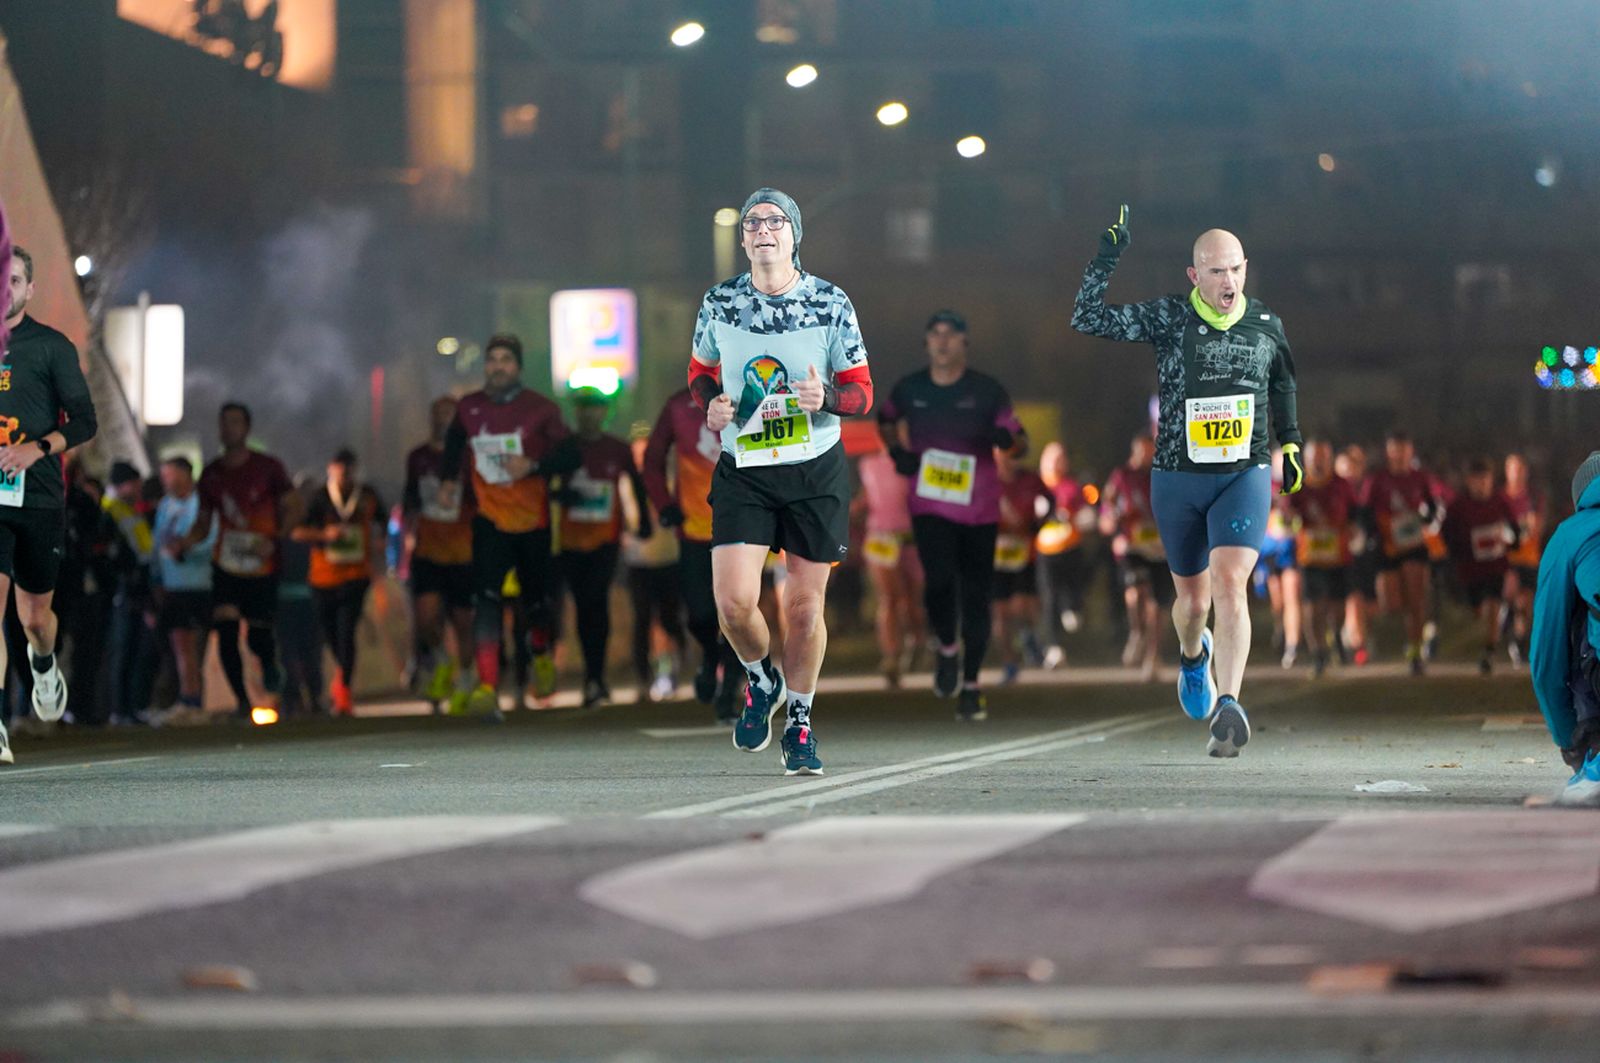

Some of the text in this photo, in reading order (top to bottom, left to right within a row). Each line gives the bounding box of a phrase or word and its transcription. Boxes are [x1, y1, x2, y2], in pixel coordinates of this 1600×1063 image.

[1223, 403, 1231, 411] DE
[1194, 413, 1208, 421] SAN
[1202, 419, 1242, 440] 1720
